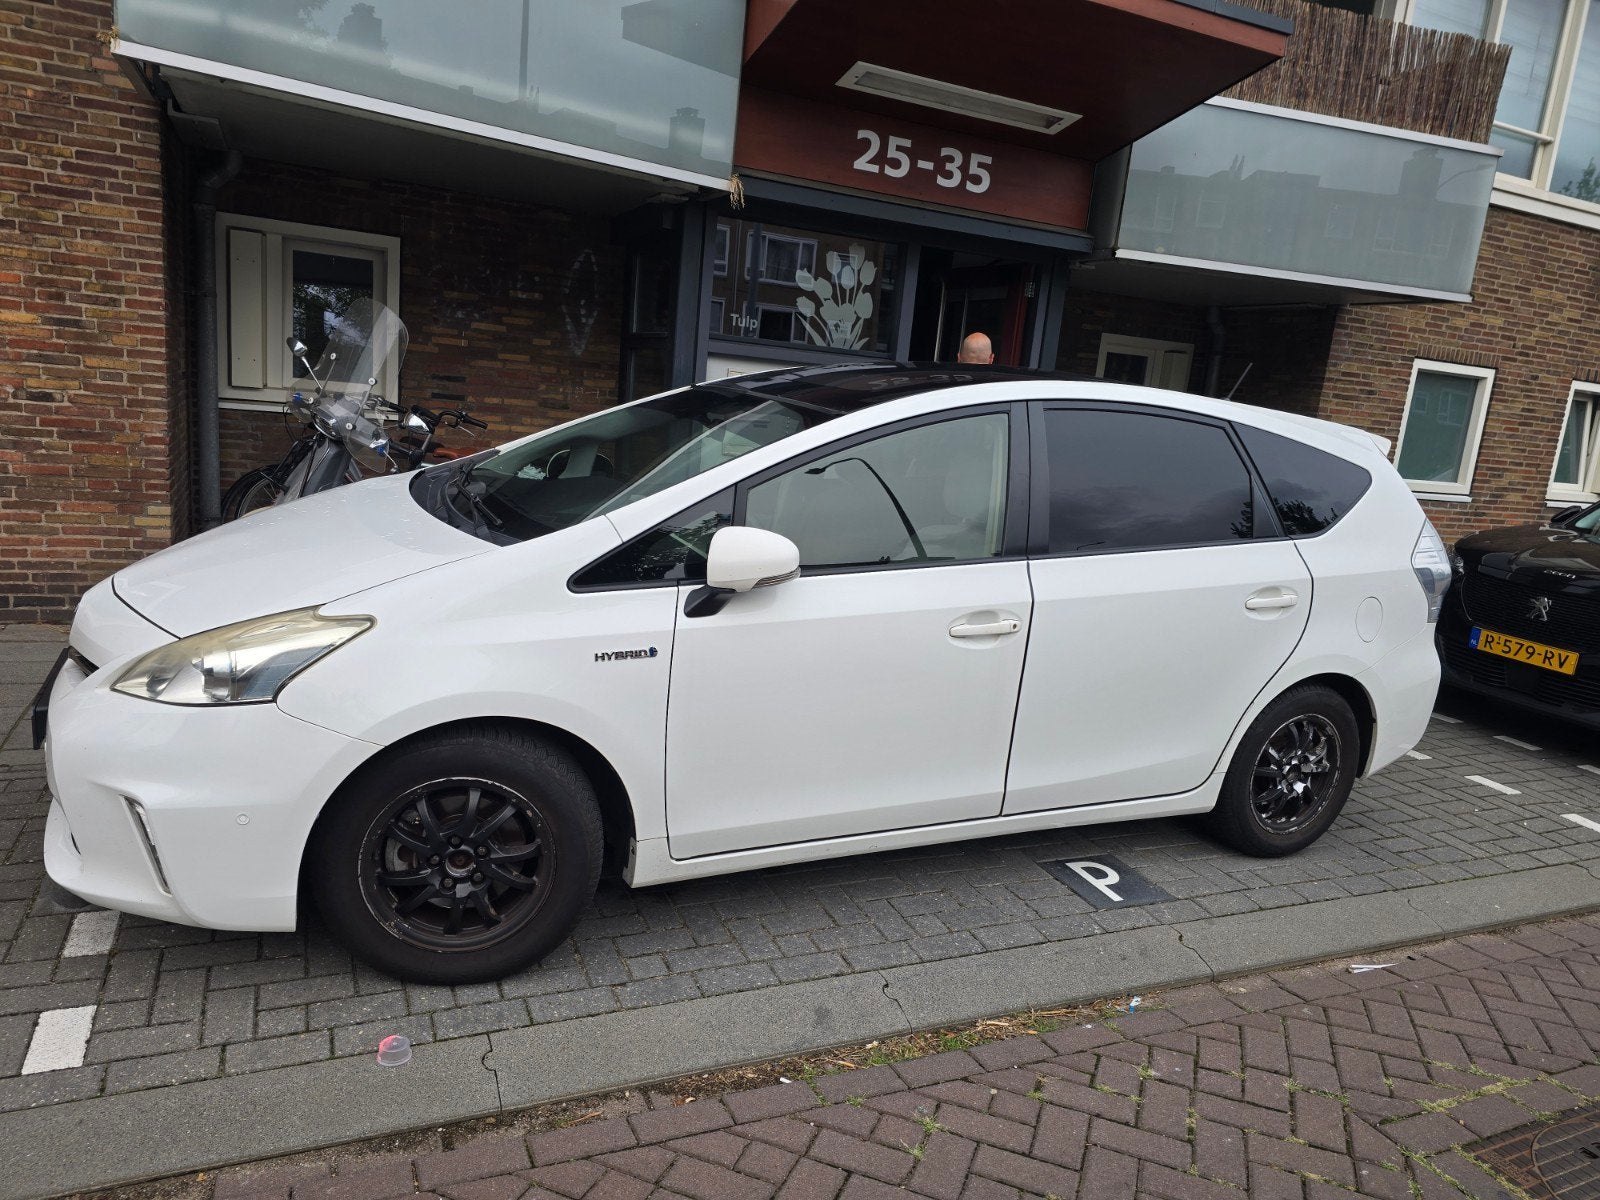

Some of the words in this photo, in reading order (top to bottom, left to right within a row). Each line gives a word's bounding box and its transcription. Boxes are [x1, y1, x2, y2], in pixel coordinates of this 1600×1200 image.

[853, 129, 993, 194] 25-35
[730, 313, 758, 331] Tulp
[594, 649, 648, 662] HYBRID
[1483, 634, 1569, 669] R-579-RV
[1065, 861, 1124, 902] P
